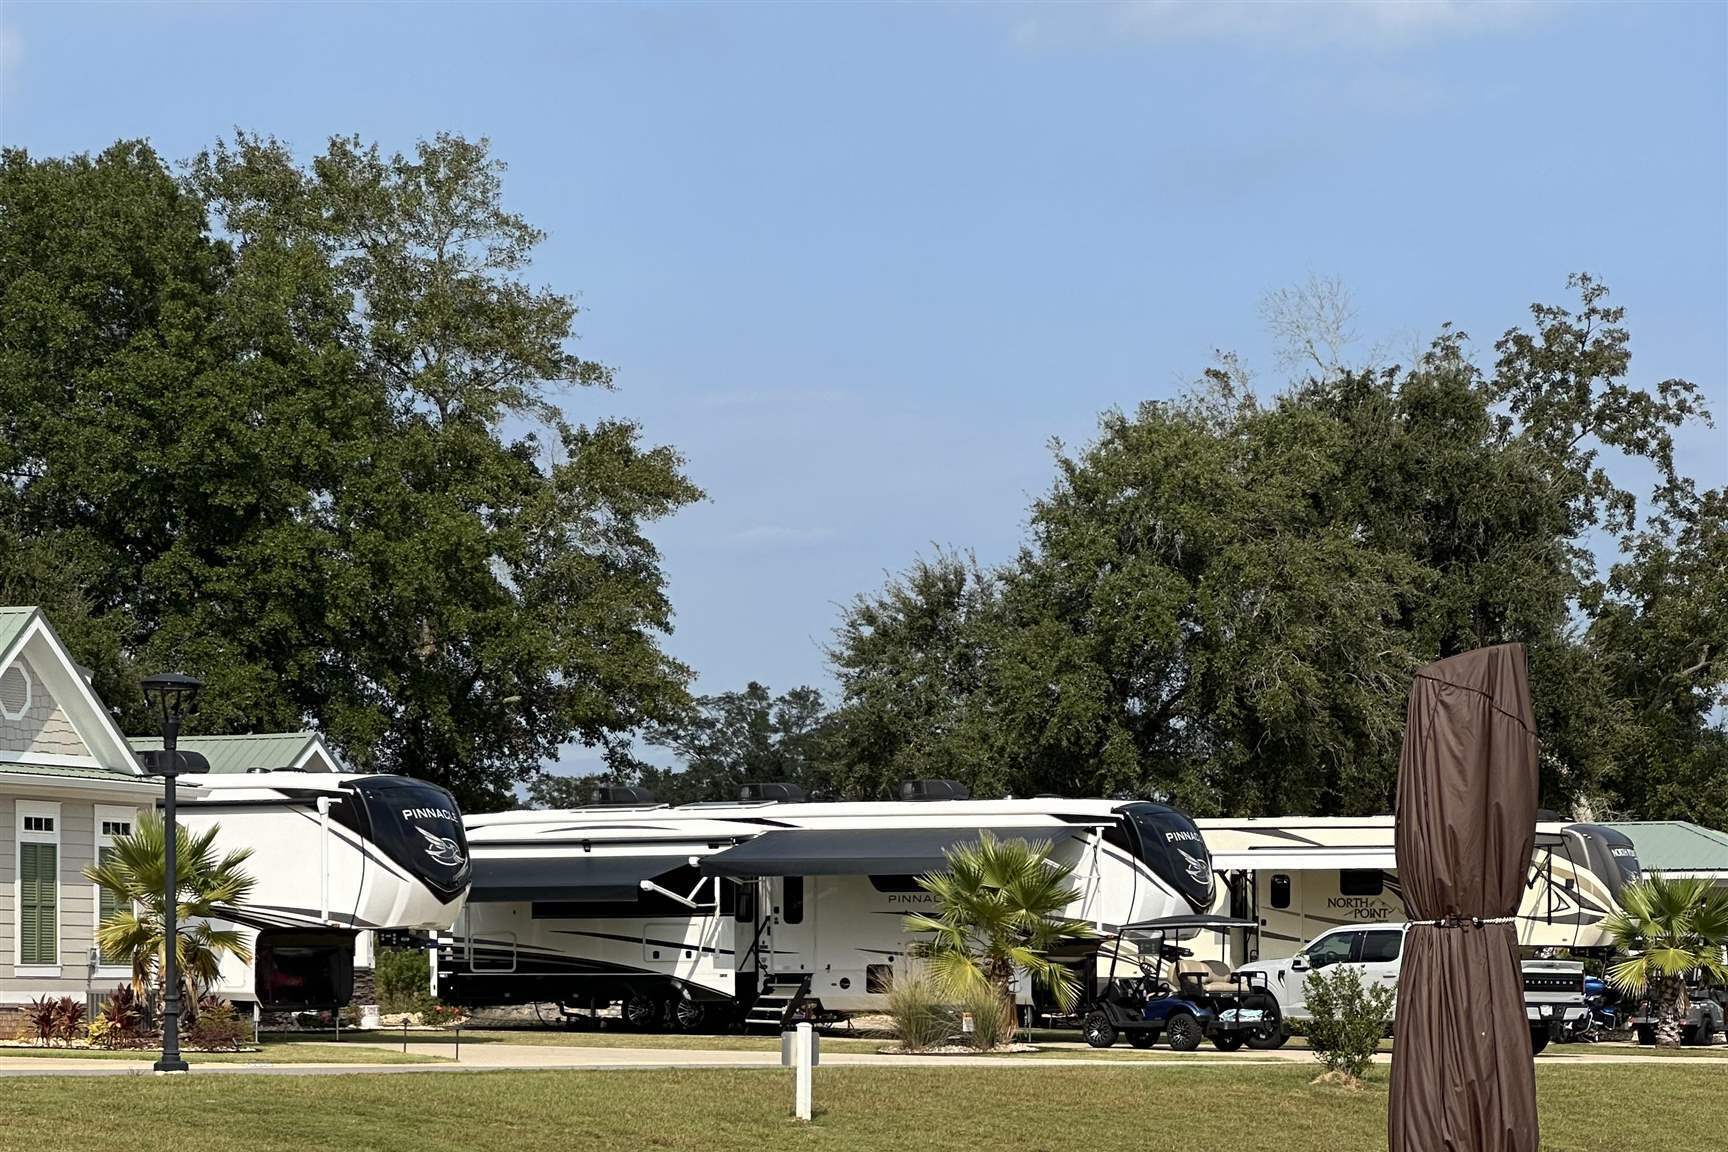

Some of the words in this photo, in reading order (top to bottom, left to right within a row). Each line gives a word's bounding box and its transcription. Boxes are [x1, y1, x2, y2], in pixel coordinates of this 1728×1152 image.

[1165, 831, 1201, 842] PINNAC
[888, 894, 942, 903] PINNAC
[1327, 897, 1368, 908] NORTH
[1354, 908, 1388, 919] POINT
